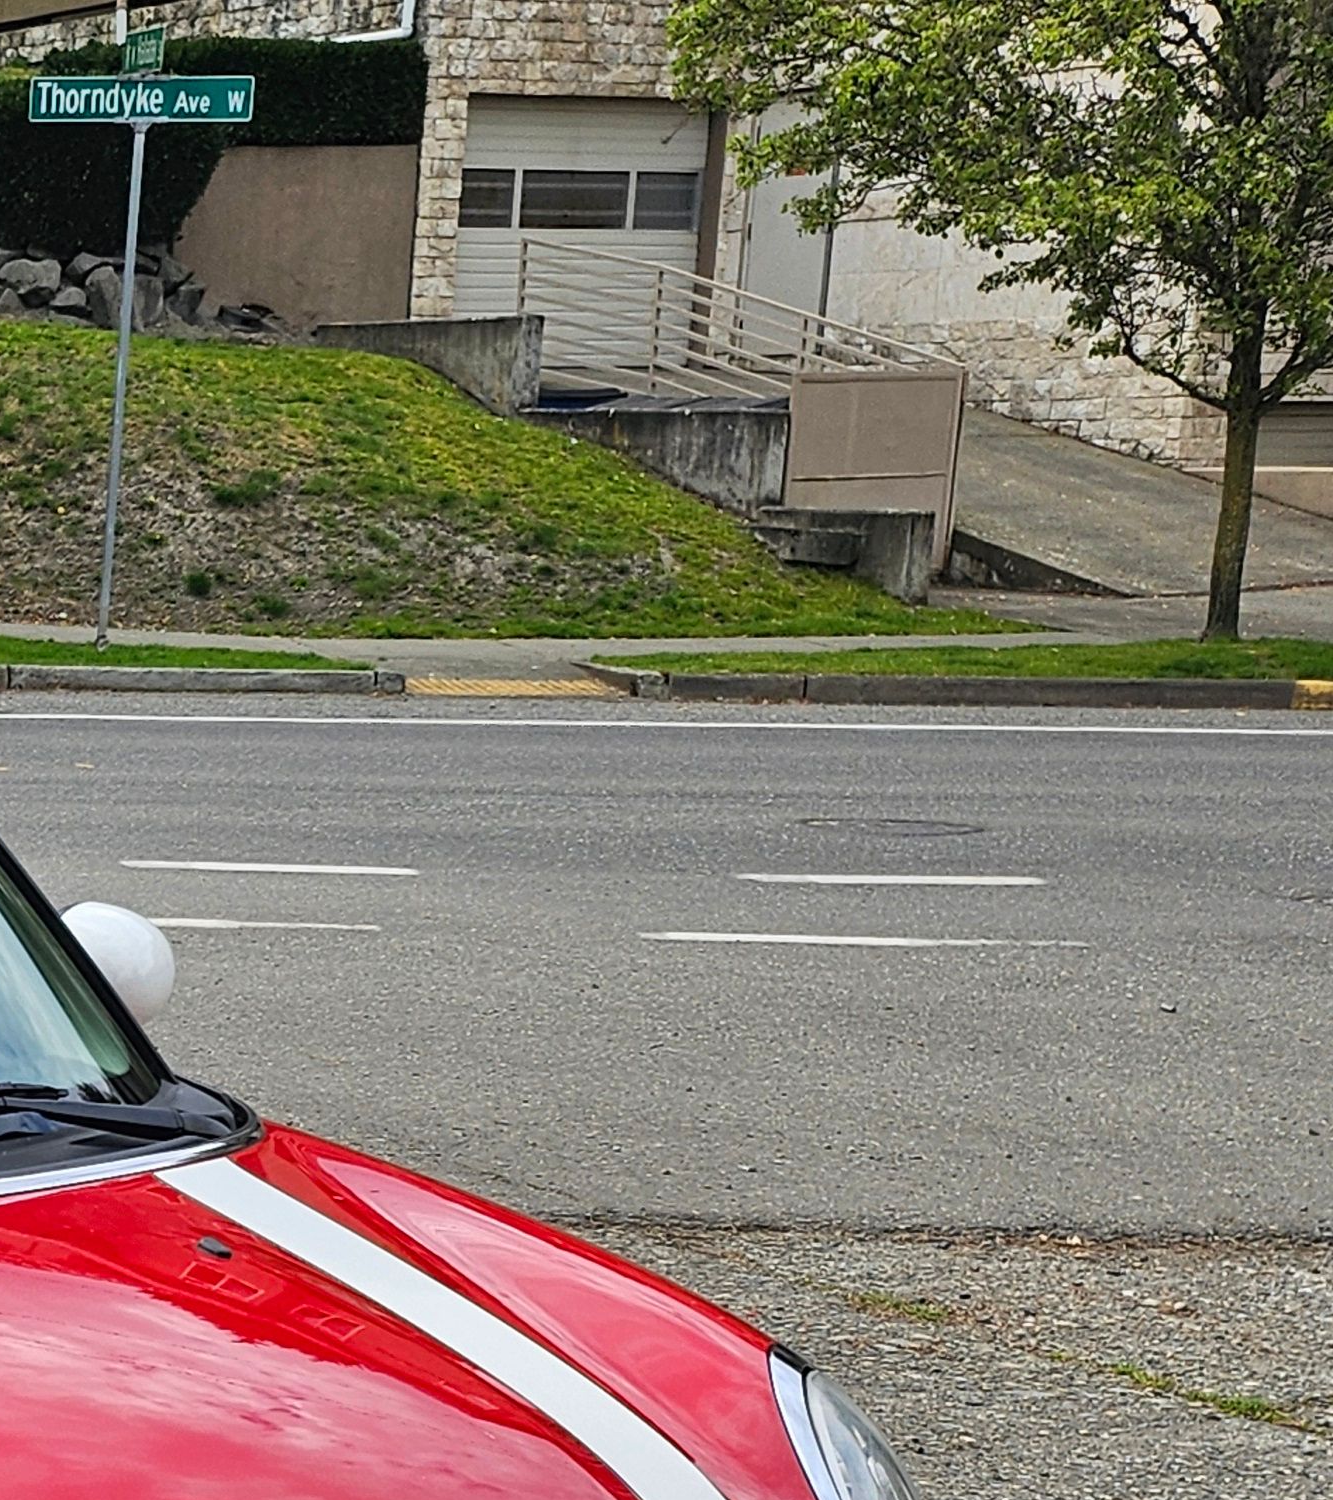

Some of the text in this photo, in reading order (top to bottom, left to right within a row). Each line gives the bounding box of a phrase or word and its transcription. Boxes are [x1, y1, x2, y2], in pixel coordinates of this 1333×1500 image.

[37, 82, 245, 118] Thorndyke Ave W
